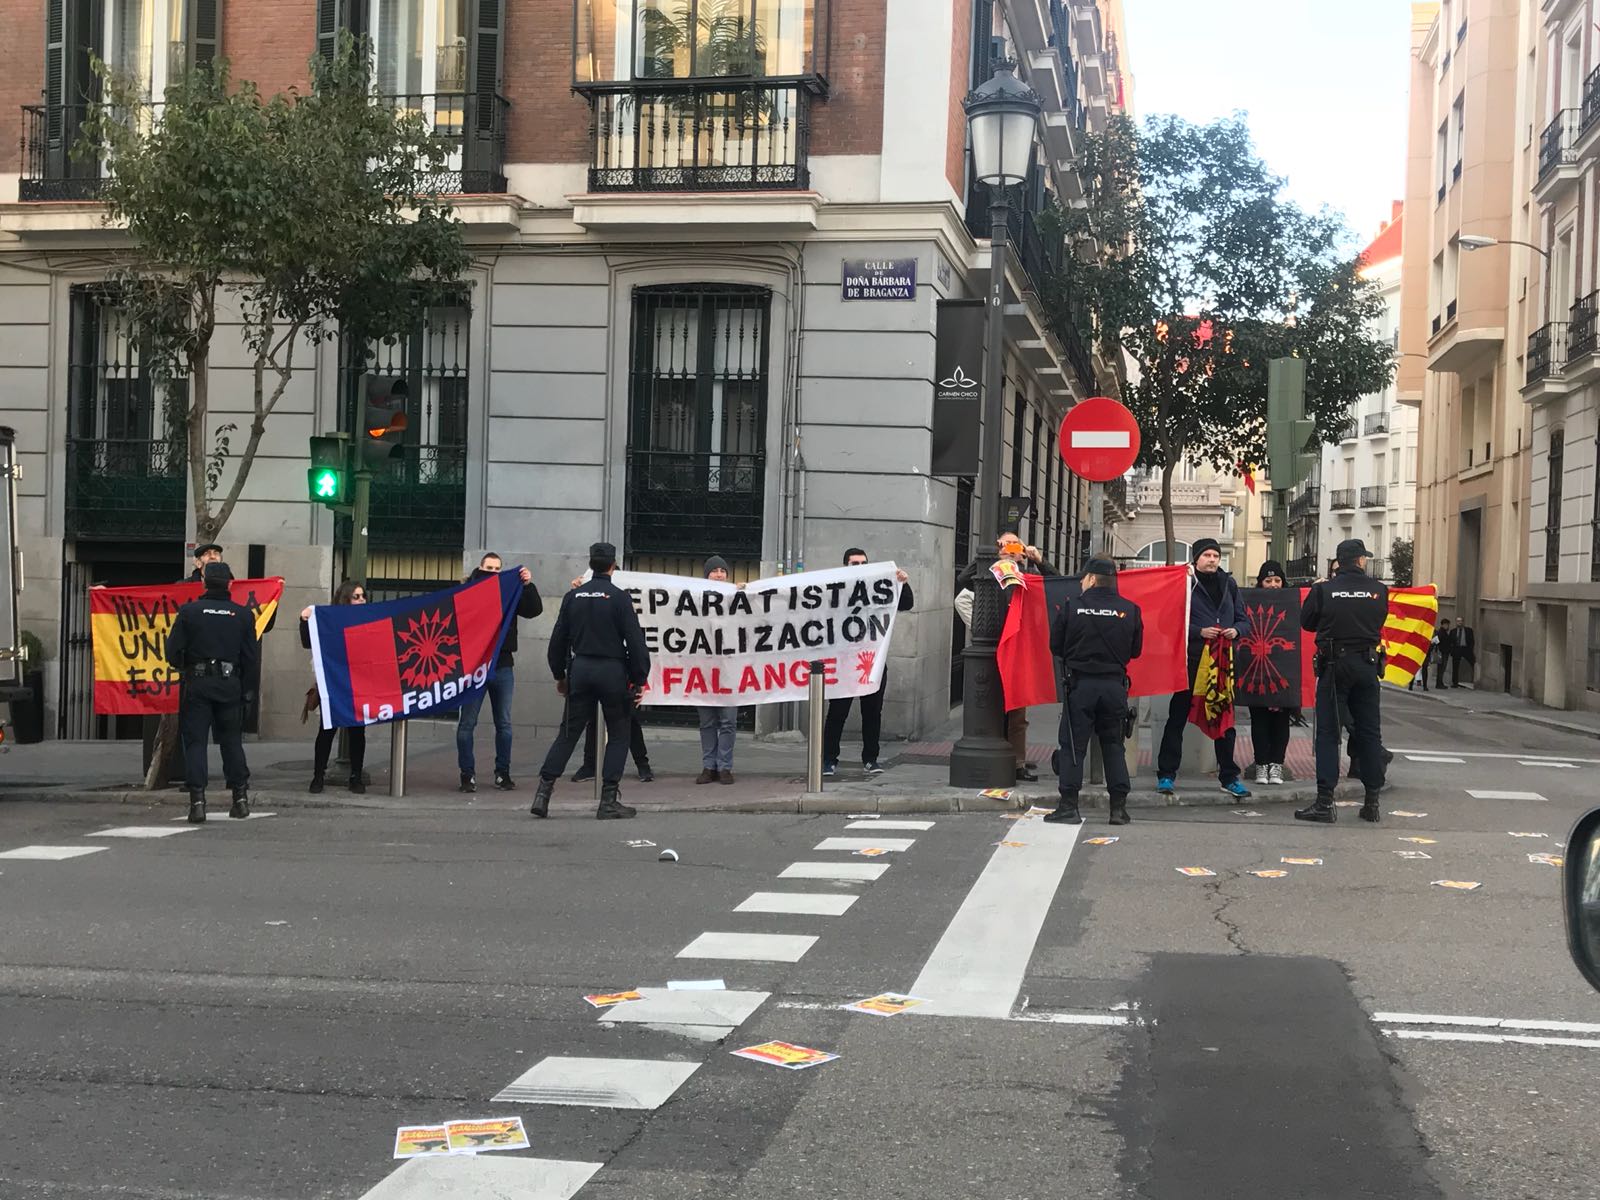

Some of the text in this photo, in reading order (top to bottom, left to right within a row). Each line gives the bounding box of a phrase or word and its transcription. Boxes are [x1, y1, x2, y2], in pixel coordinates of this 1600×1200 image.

[864, 261, 895, 270] CALLE
[846, 275, 912, 286] DOÑA BÁRBARA
[847, 287, 910, 298] DE BRAGANZA
[624, 578, 895, 617] EPARATISTAS
[1331, 591, 1373, 599] POLICIA
[1077, 608, 1119, 617] POLICIA
[644, 606, 891, 656] EGALIZACIÓN
[126, 664, 183, 698] ESP
[663, 657, 839, 695] FALANGE
[362, 659, 493, 725] La Falang
